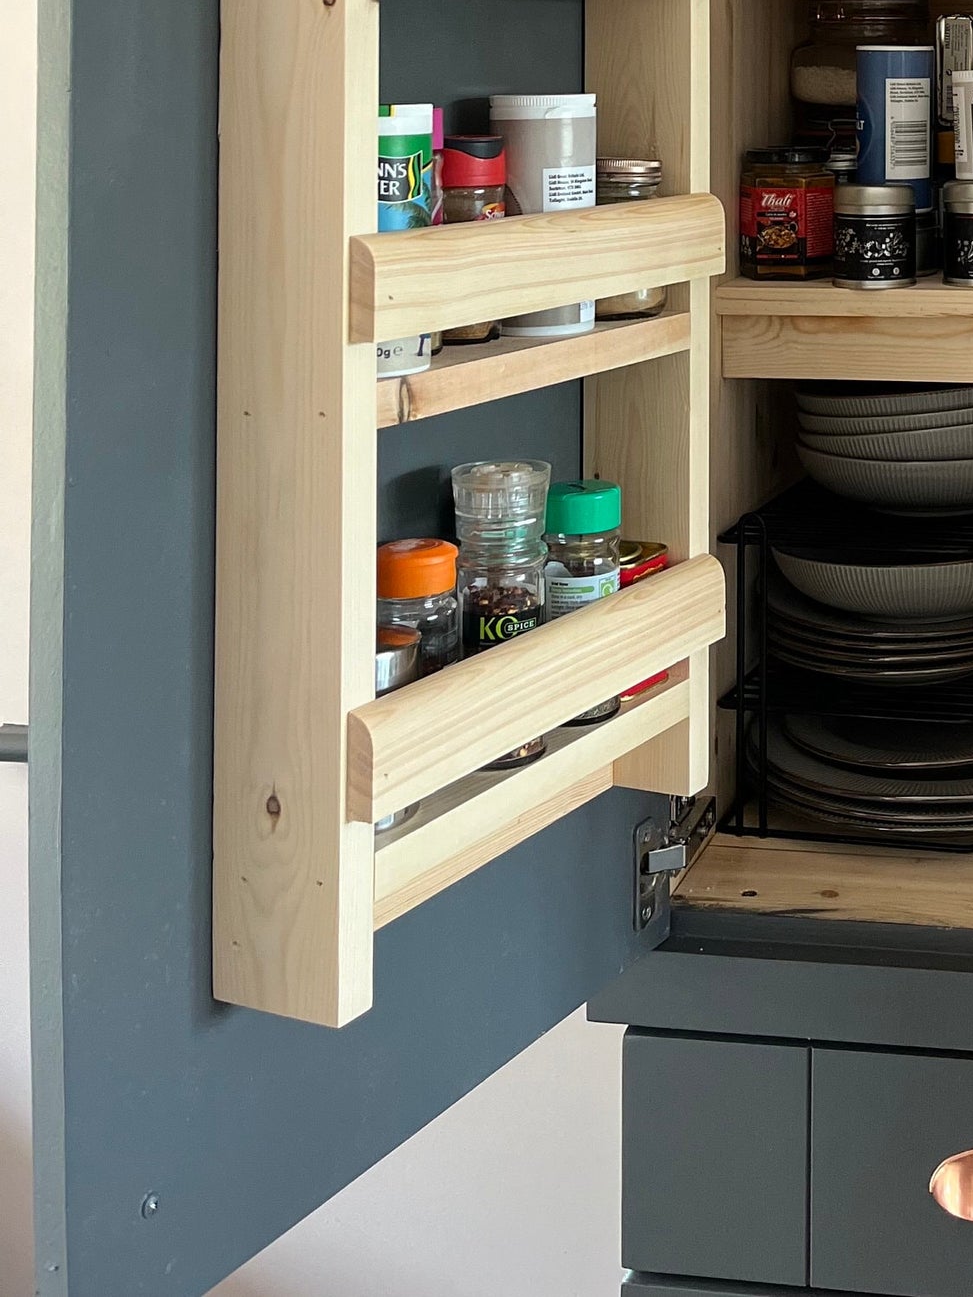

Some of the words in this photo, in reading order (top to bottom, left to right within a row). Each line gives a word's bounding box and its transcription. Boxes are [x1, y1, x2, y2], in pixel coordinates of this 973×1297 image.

[378, 180, 400, 196] ER
[761, 192, 795, 208] Thali
[507, 620, 534, 632] SPICE
